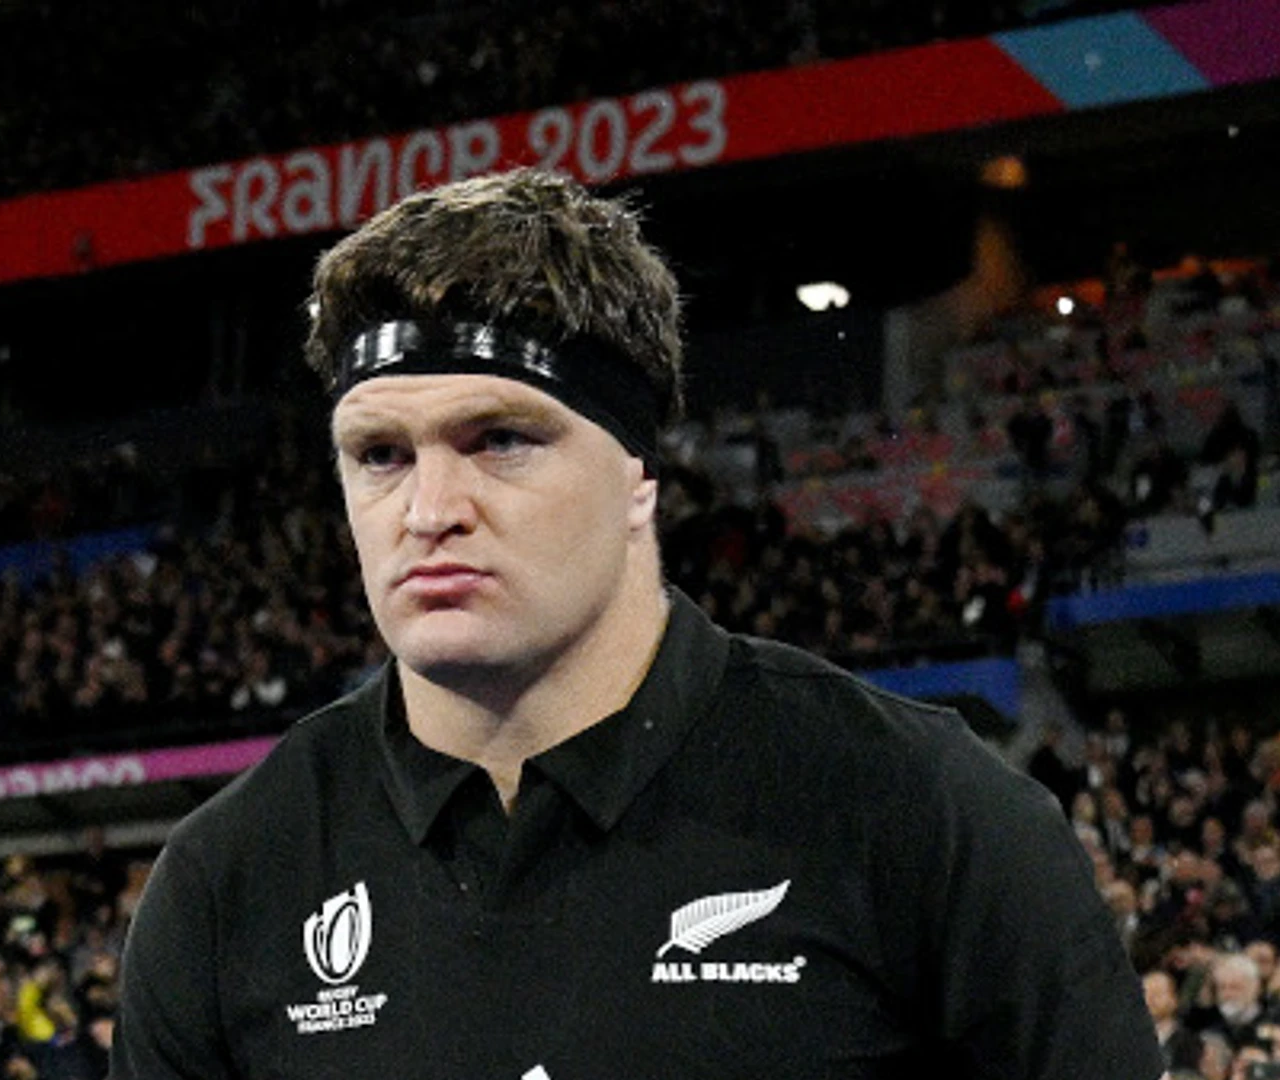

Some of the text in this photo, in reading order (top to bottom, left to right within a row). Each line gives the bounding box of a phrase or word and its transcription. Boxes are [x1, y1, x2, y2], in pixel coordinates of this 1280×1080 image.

[526, 79, 729, 184] 2023
[652, 961, 801, 984] ALL BLACKS
[286, 1000, 353, 1022] WORLD
